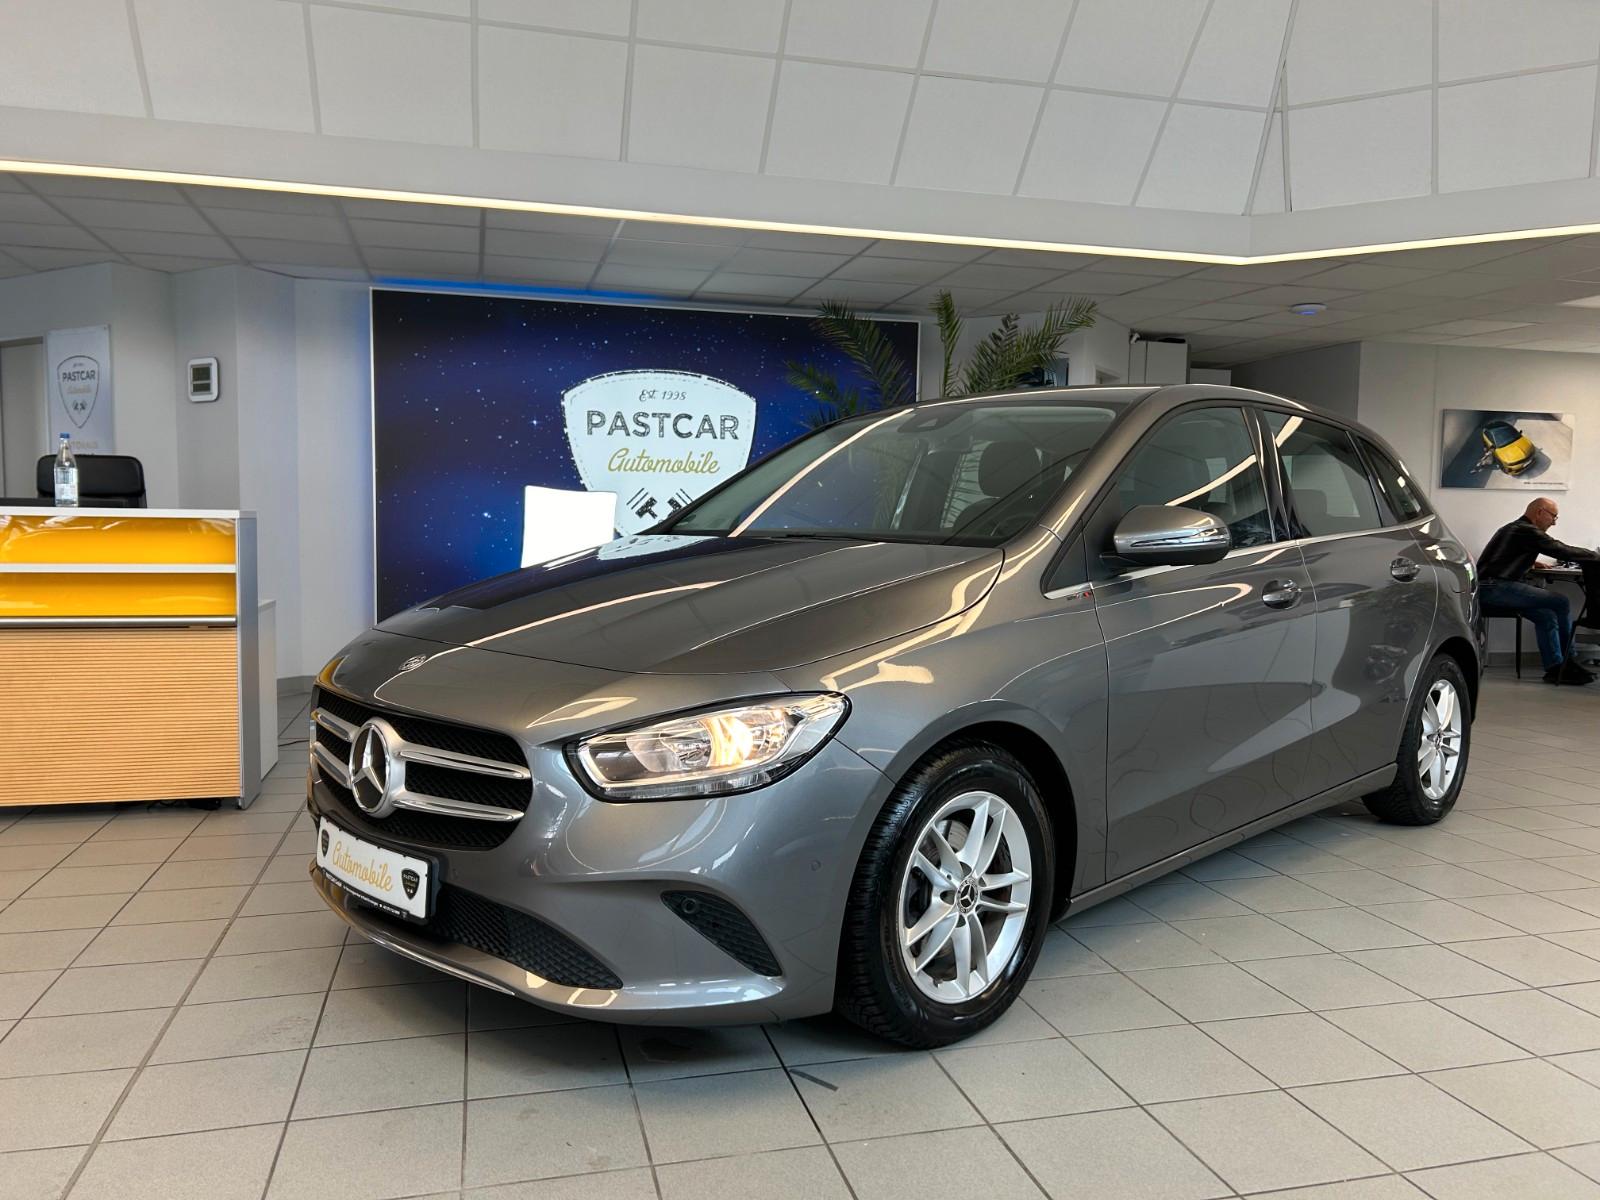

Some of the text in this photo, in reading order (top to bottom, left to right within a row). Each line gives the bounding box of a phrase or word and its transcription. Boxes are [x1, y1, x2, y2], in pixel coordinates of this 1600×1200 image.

[62, 370, 96, 382] PASTCAR
[586, 410, 739, 440] PASTCAR
[608, 447, 720, 474] Automobile
[333, 841, 393, 891] Automobile
